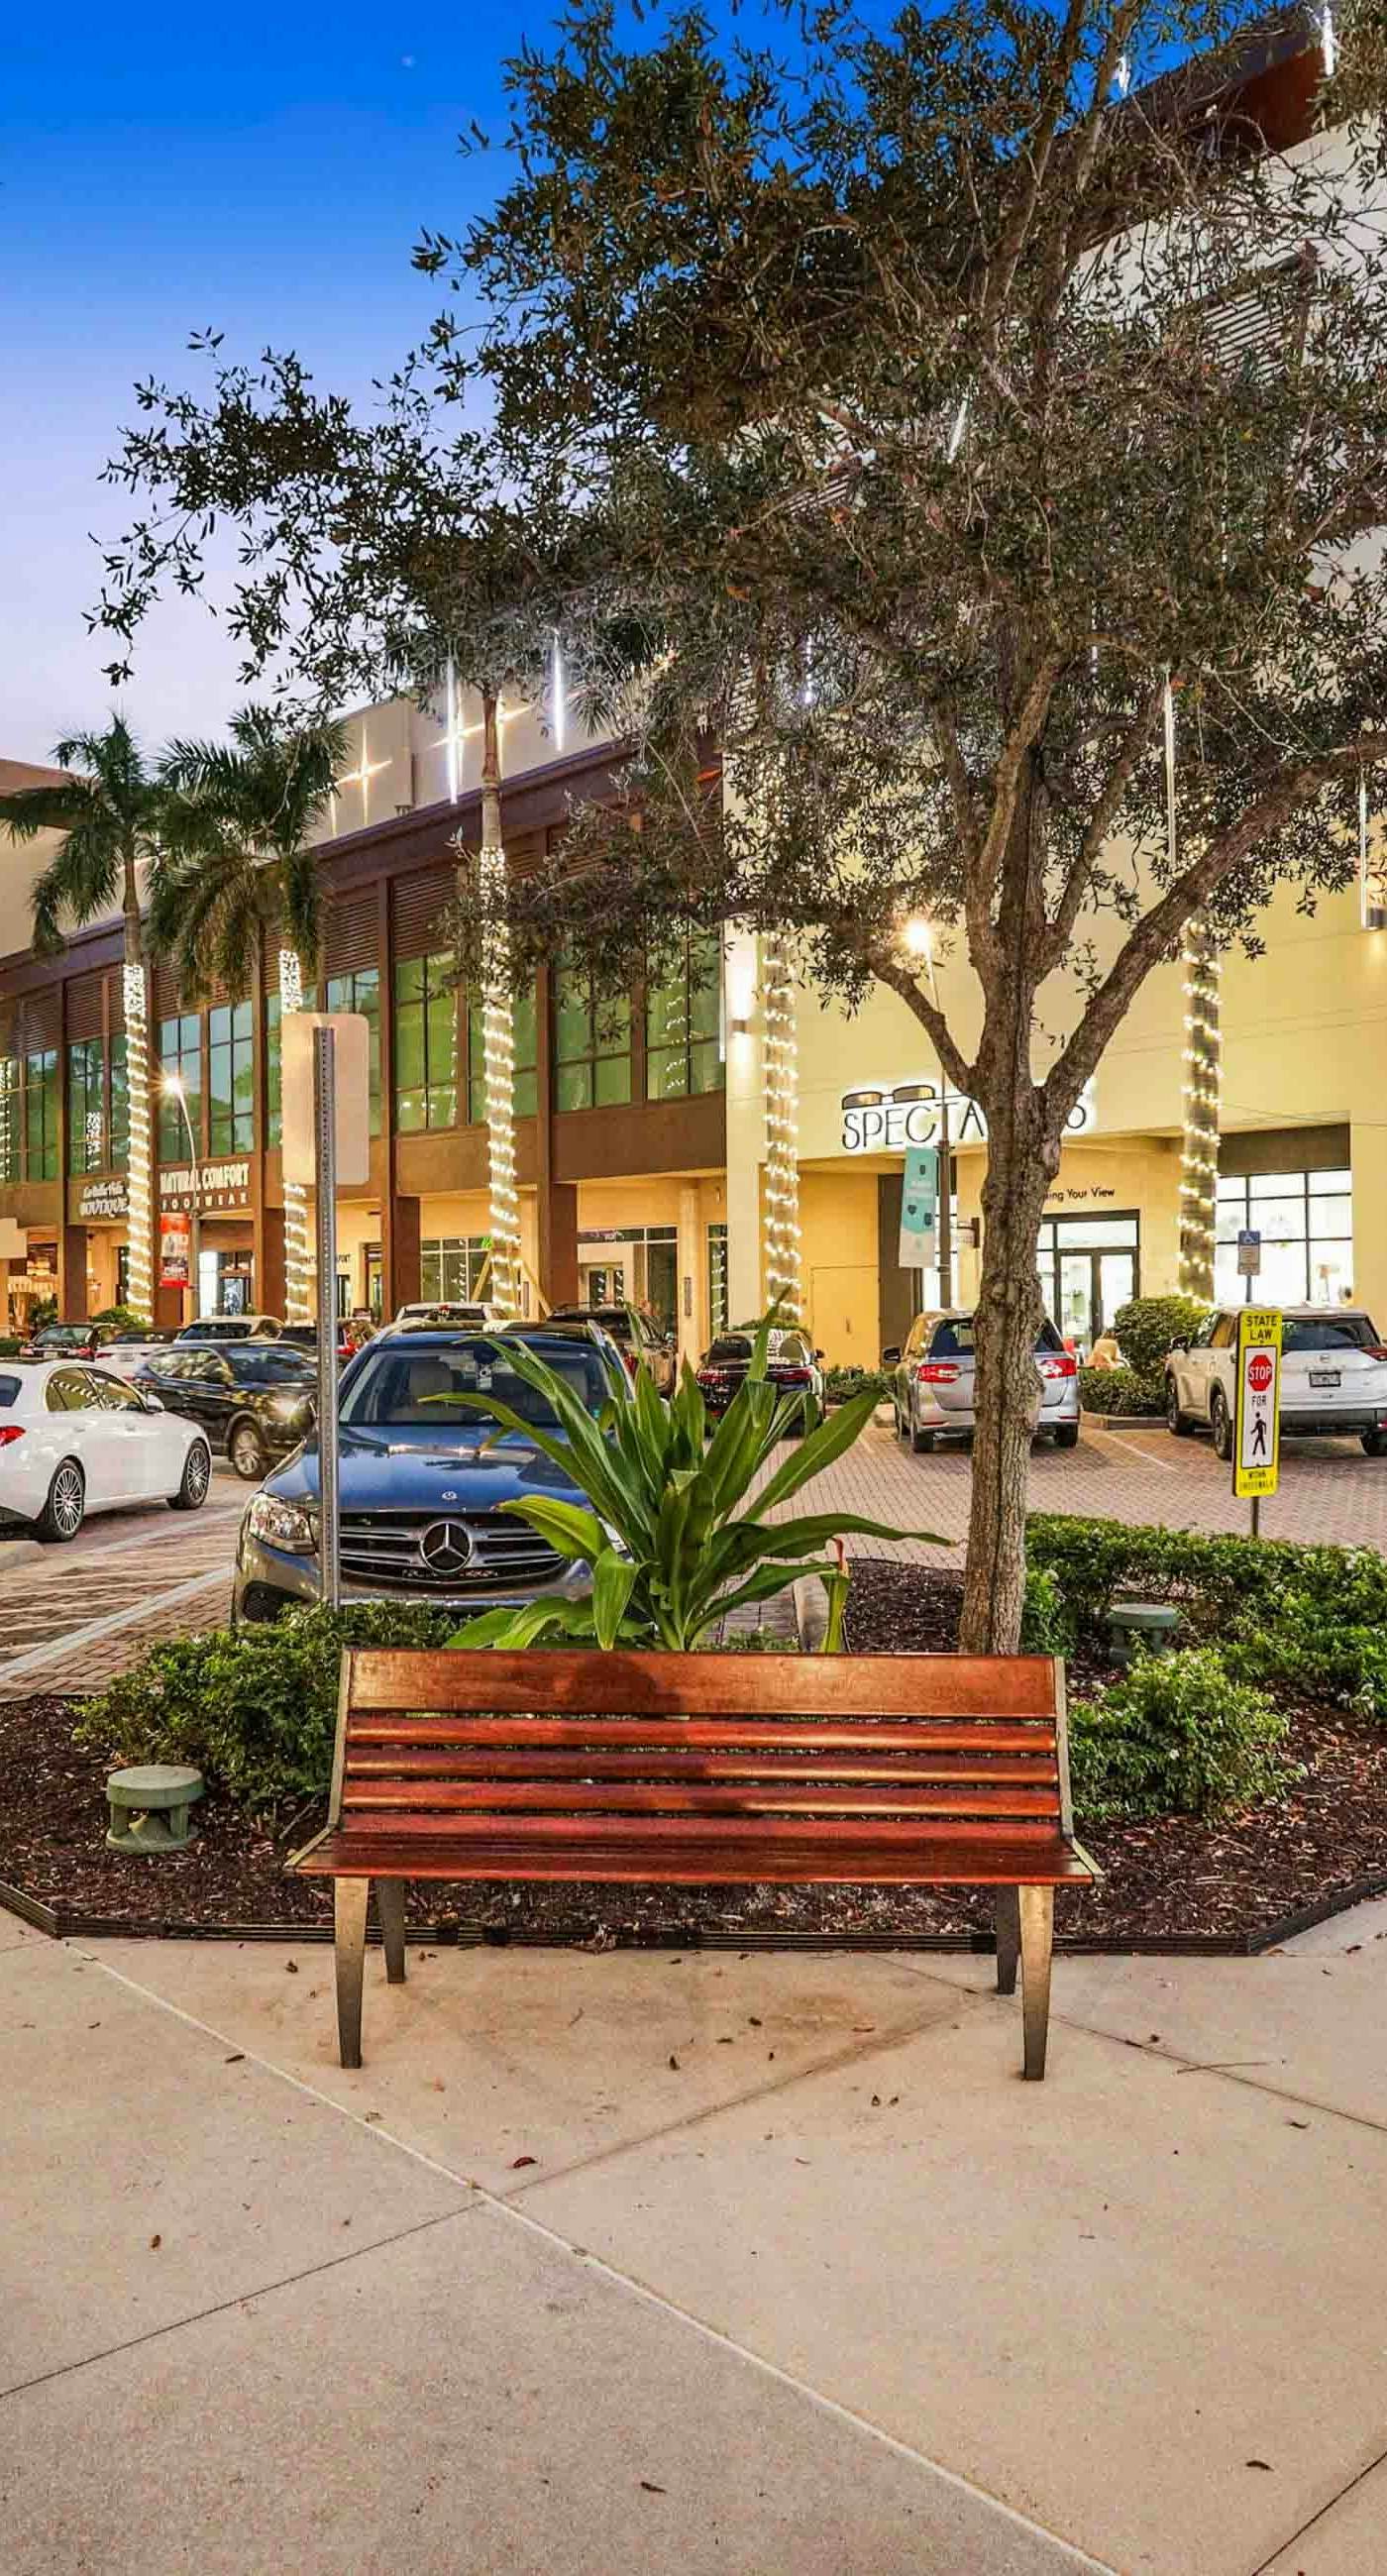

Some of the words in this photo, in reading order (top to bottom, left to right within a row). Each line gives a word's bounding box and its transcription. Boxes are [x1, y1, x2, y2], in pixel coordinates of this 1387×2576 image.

[202, 1163, 250, 1190] COMFORT
[1067, 1189, 1088, 1199] Your
[1091, 1187, 1116, 1198] View
[1245, 1315, 1278, 1328] STATE
[1249, 1328, 1273, 1341] LAW
[1248, 1366, 1273, 1381] STOP
[1251, 1394, 1268, 1407] FOR
